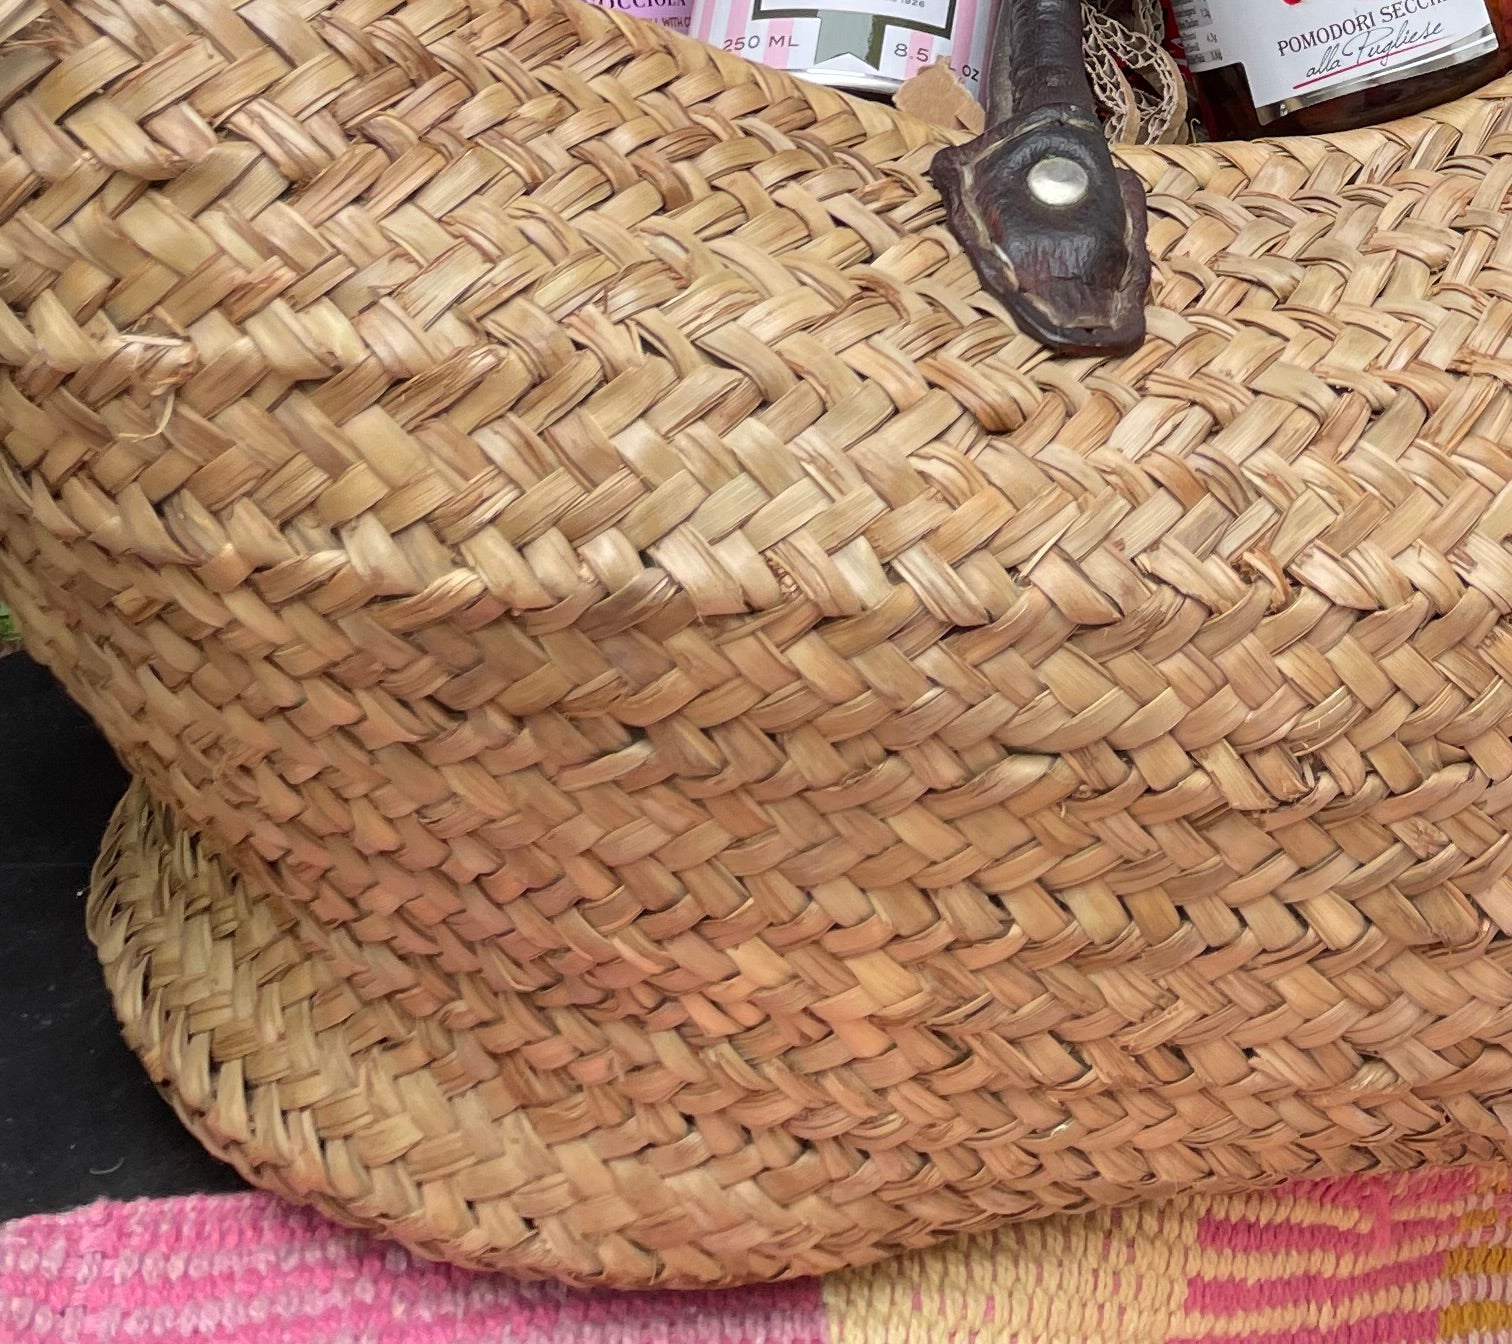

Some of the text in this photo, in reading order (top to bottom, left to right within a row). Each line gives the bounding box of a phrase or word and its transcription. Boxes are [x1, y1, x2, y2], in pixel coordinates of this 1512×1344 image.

[1277, 11, 1377, 56] POMODORI
[1306, 20, 1446, 78] alla Pugliese
[723, 35, 761, 52] 250
[768, 35, 799, 48] ML
[894, 43, 929, 63] 8.5
[961, 64, 980, 82] OZ
